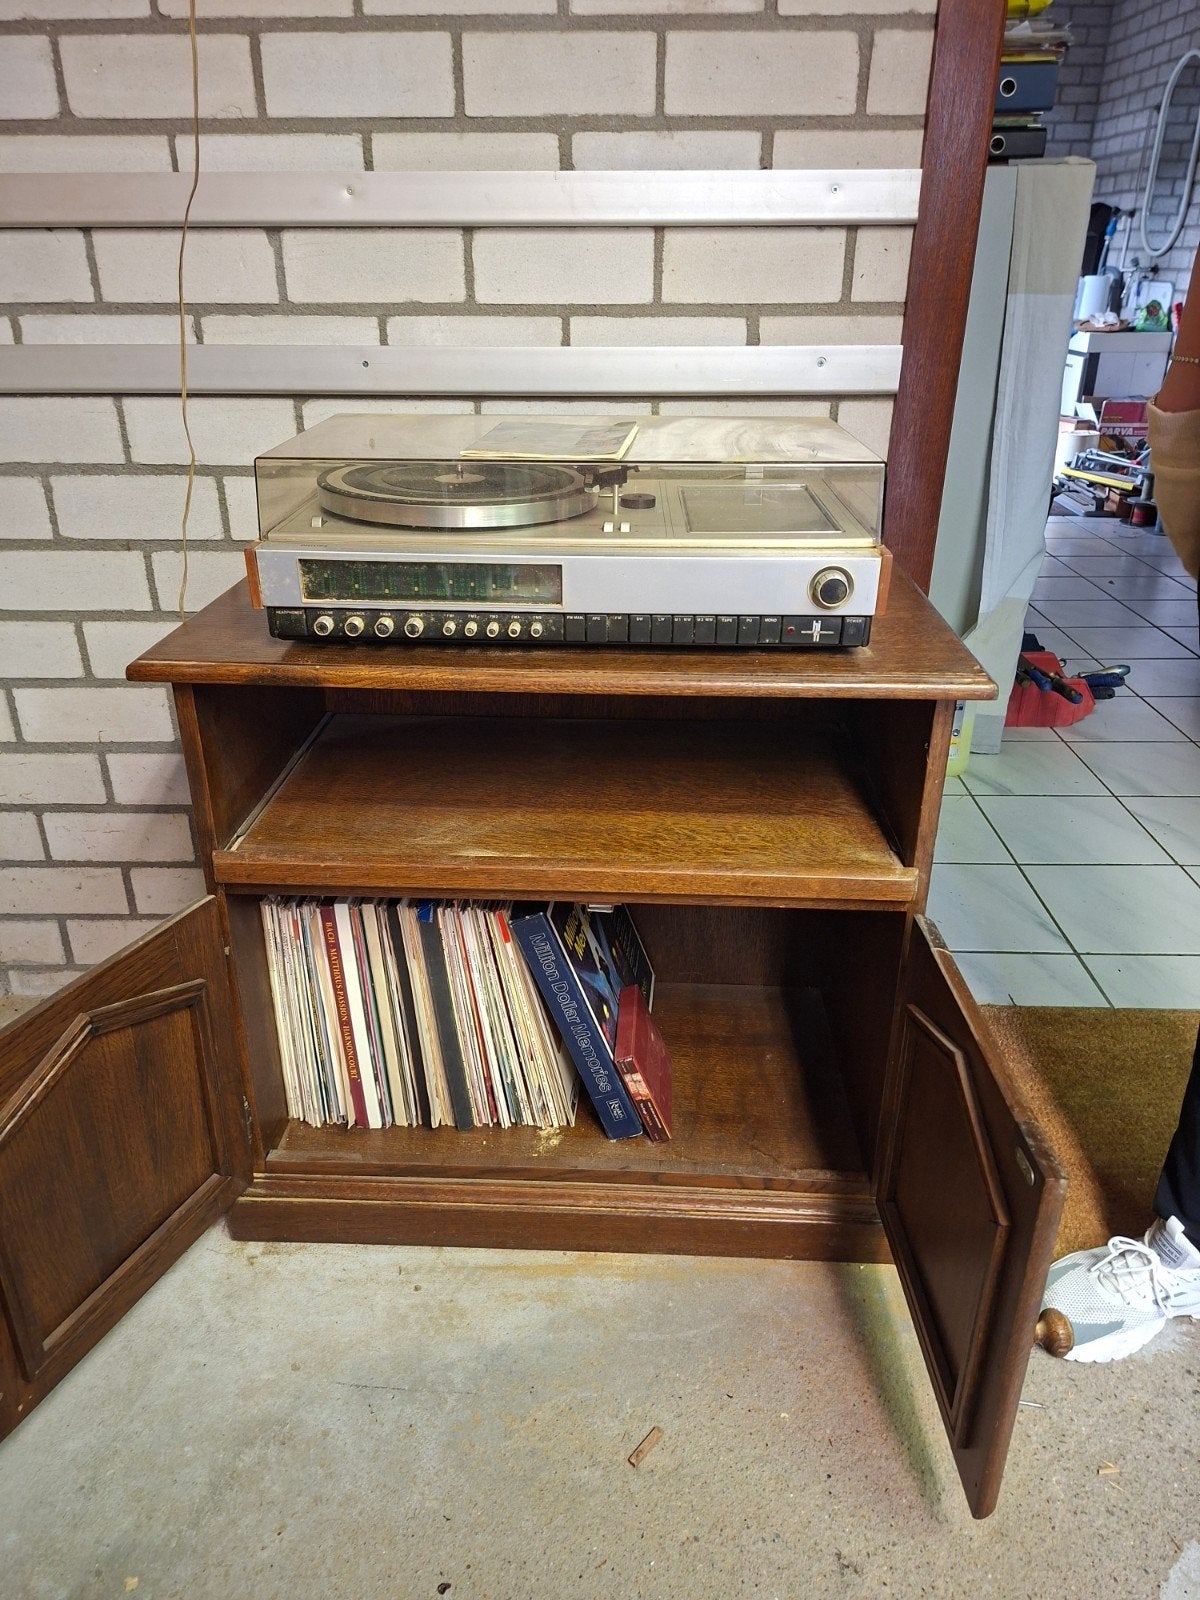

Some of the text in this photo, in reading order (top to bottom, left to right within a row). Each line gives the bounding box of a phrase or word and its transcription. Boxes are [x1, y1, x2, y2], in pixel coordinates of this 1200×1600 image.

[1101, 427, 1134, 436] PARVA
[326, 922, 335, 943] BACH
[343, 1025, 358, 1078] HARNONCOURT
[529, 932, 560, 981] Million
[551, 980, 580, 1022] Dollar
[570, 1022, 612, 1093] Memories
